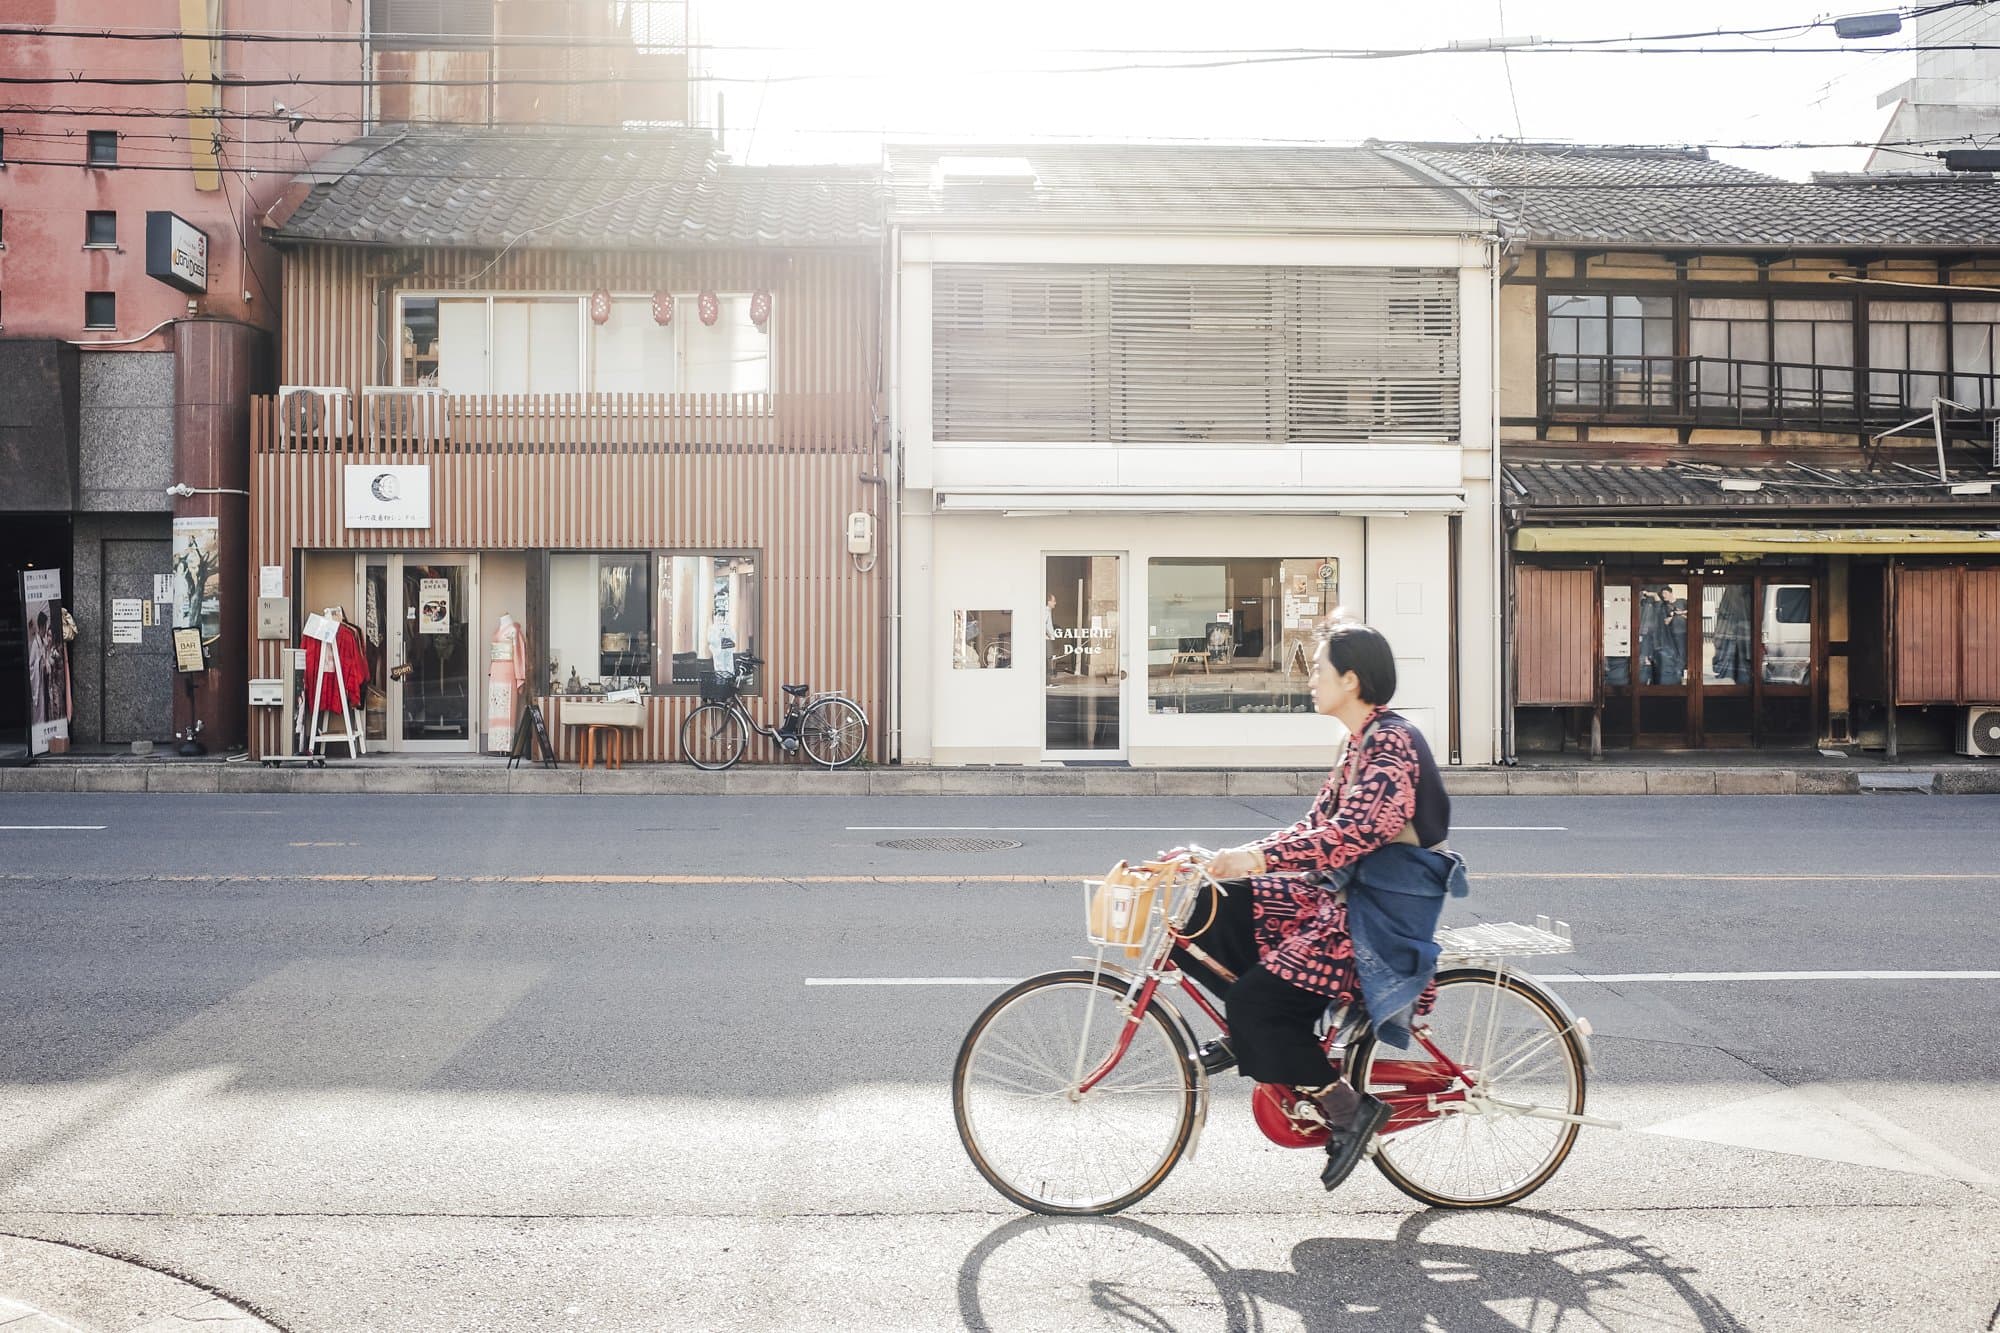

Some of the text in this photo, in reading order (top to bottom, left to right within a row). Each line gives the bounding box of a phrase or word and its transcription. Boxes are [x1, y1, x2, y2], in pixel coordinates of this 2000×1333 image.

[1054, 628, 1112, 638] GALERIE
[180, 642, 196, 650] BAR
[393, 666, 411, 675] open
